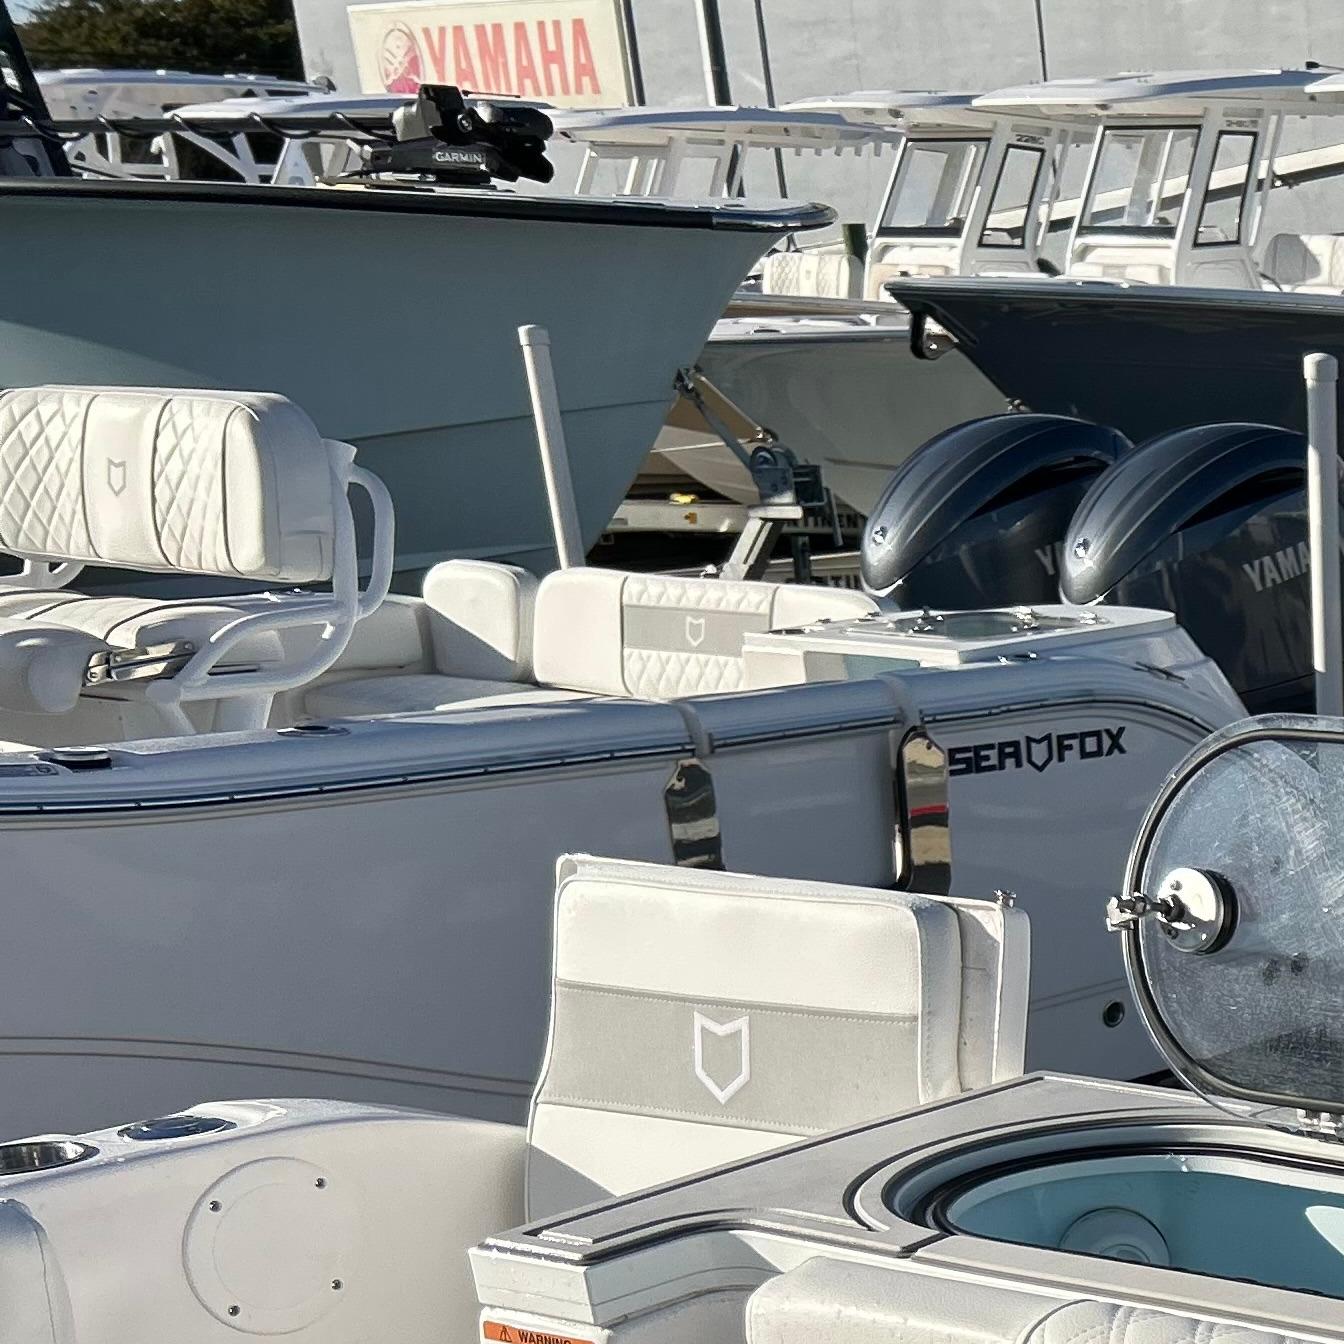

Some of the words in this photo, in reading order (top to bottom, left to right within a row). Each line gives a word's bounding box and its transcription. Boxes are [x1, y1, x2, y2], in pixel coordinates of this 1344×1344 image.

[422, 18, 601, 97] YAMAHA
[436, 151, 483, 163] GARMIN
[1243, 541, 1310, 592] YAMA
[948, 740, 1023, 776] SEA
[1056, 726, 1127, 763] FOX
